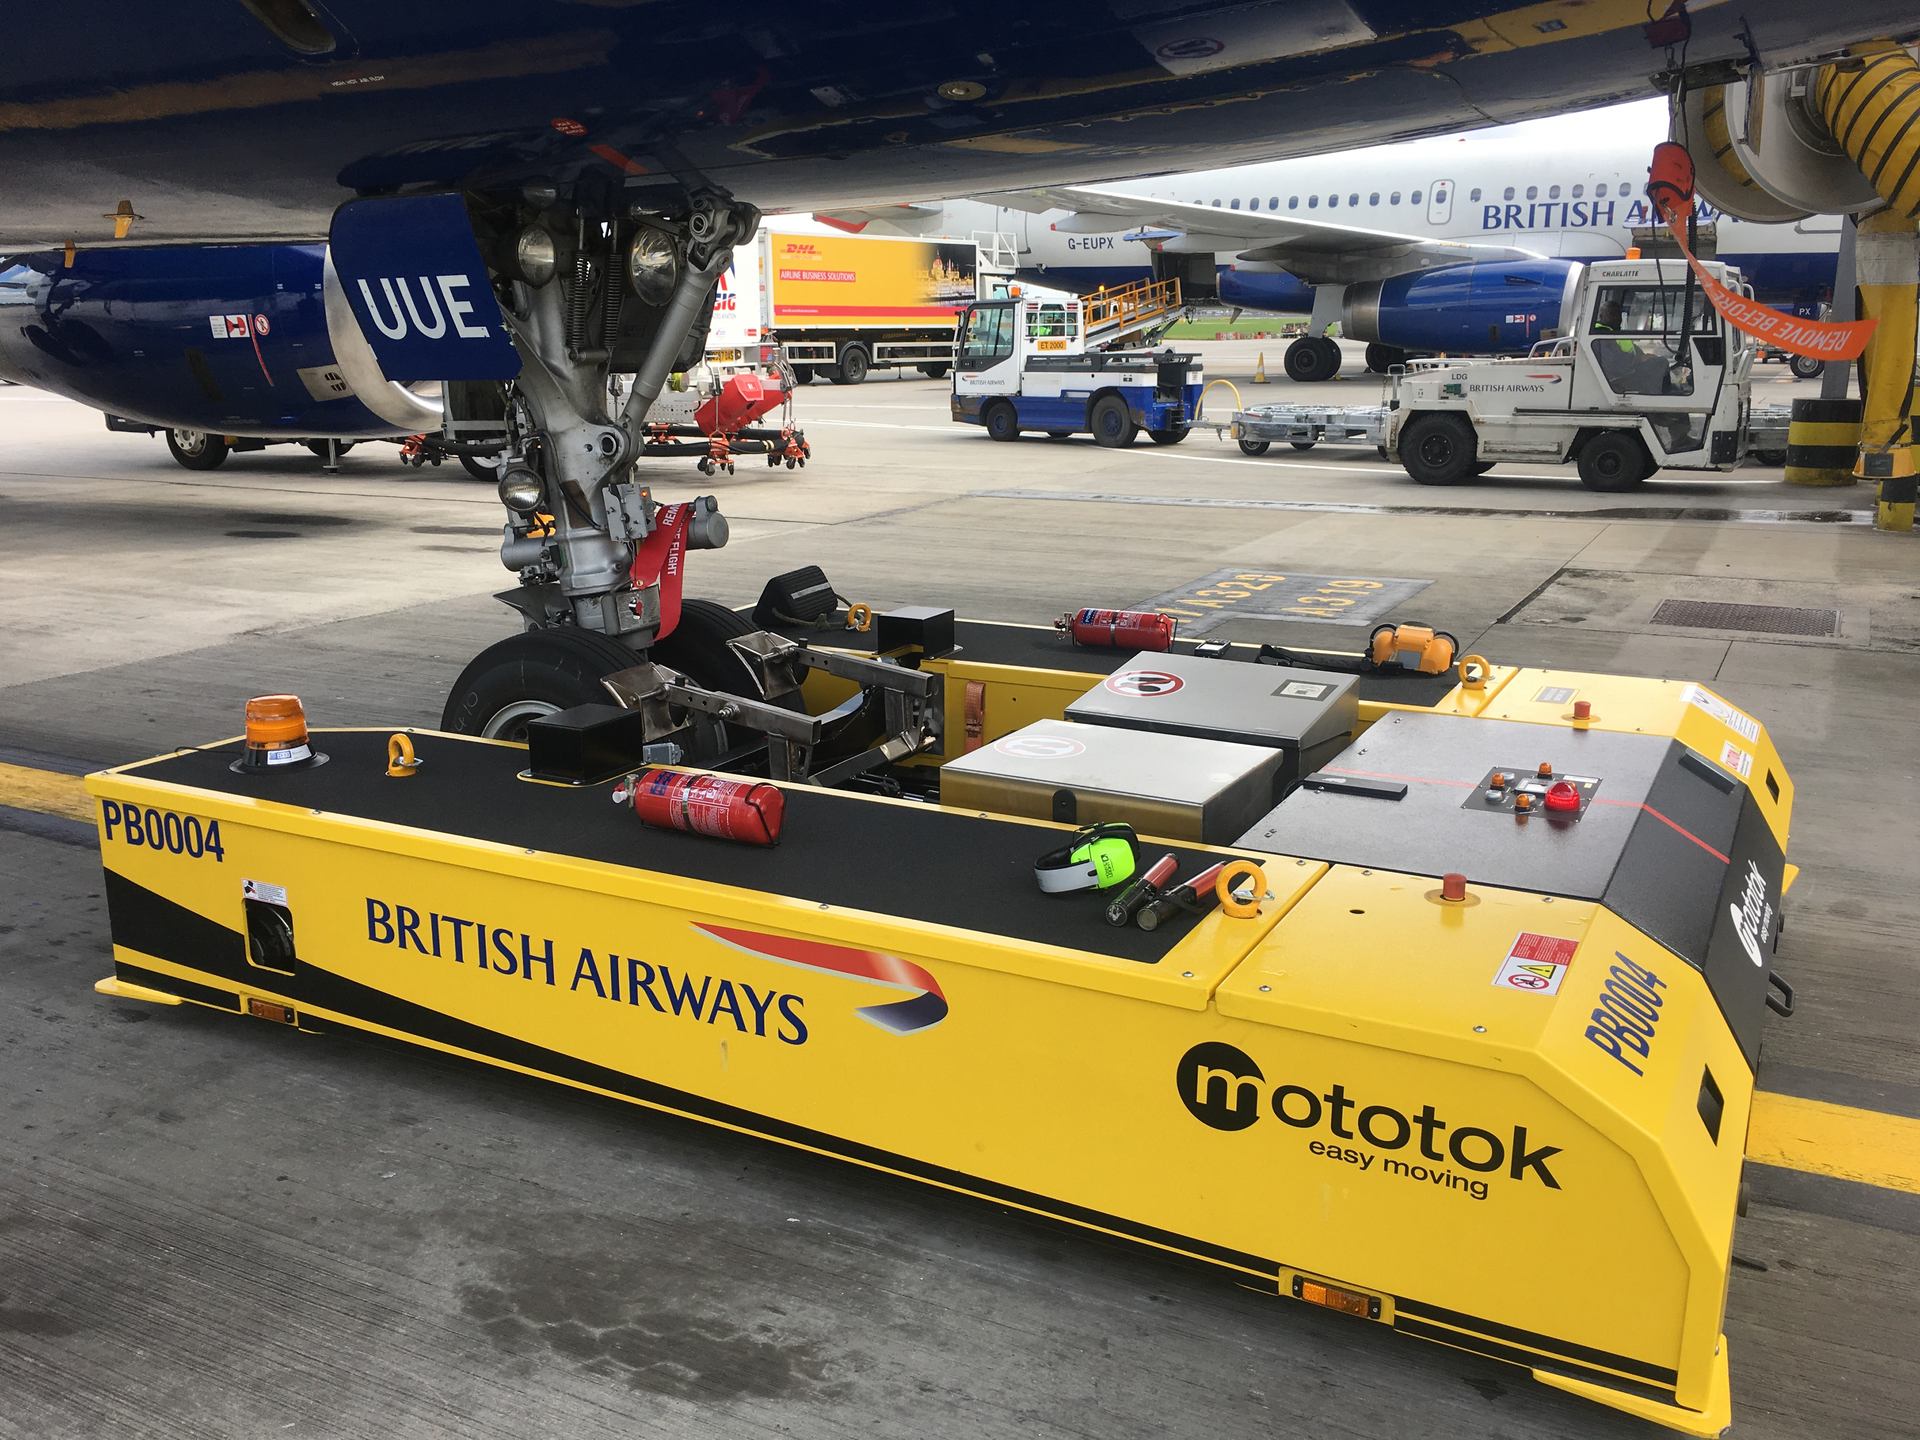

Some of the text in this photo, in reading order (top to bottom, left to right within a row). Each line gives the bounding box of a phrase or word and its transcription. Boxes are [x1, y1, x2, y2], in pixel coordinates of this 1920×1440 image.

[1482, 200, 1616, 229] BRITISH
[786, 243, 817, 254] DHL
[1068, 237, 1114, 250] G-EUPX
[780, 270, 855, 281] AIRLINE BUSINESS SOLUTIONS
[357, 274, 491, 340] UUE
[1710, 289, 1853, 351] REMOVE BEFORE
[1799, 308, 1811, 316] PX
[1469, 384, 1545, 392] BRITISH AIRWAYS
[667, 541, 680, 575] FLIGHT
[1175, 573, 1384, 618] A320 A319
[101, 800, 225, 863] PB0004
[365, 897, 809, 1046] BRITISH AIRWAYS
[1584, 951, 1668, 1077] PB0004
[1176, 1040, 1564, 1191] mototok
[1308, 1137, 1489, 1201] easy moving
